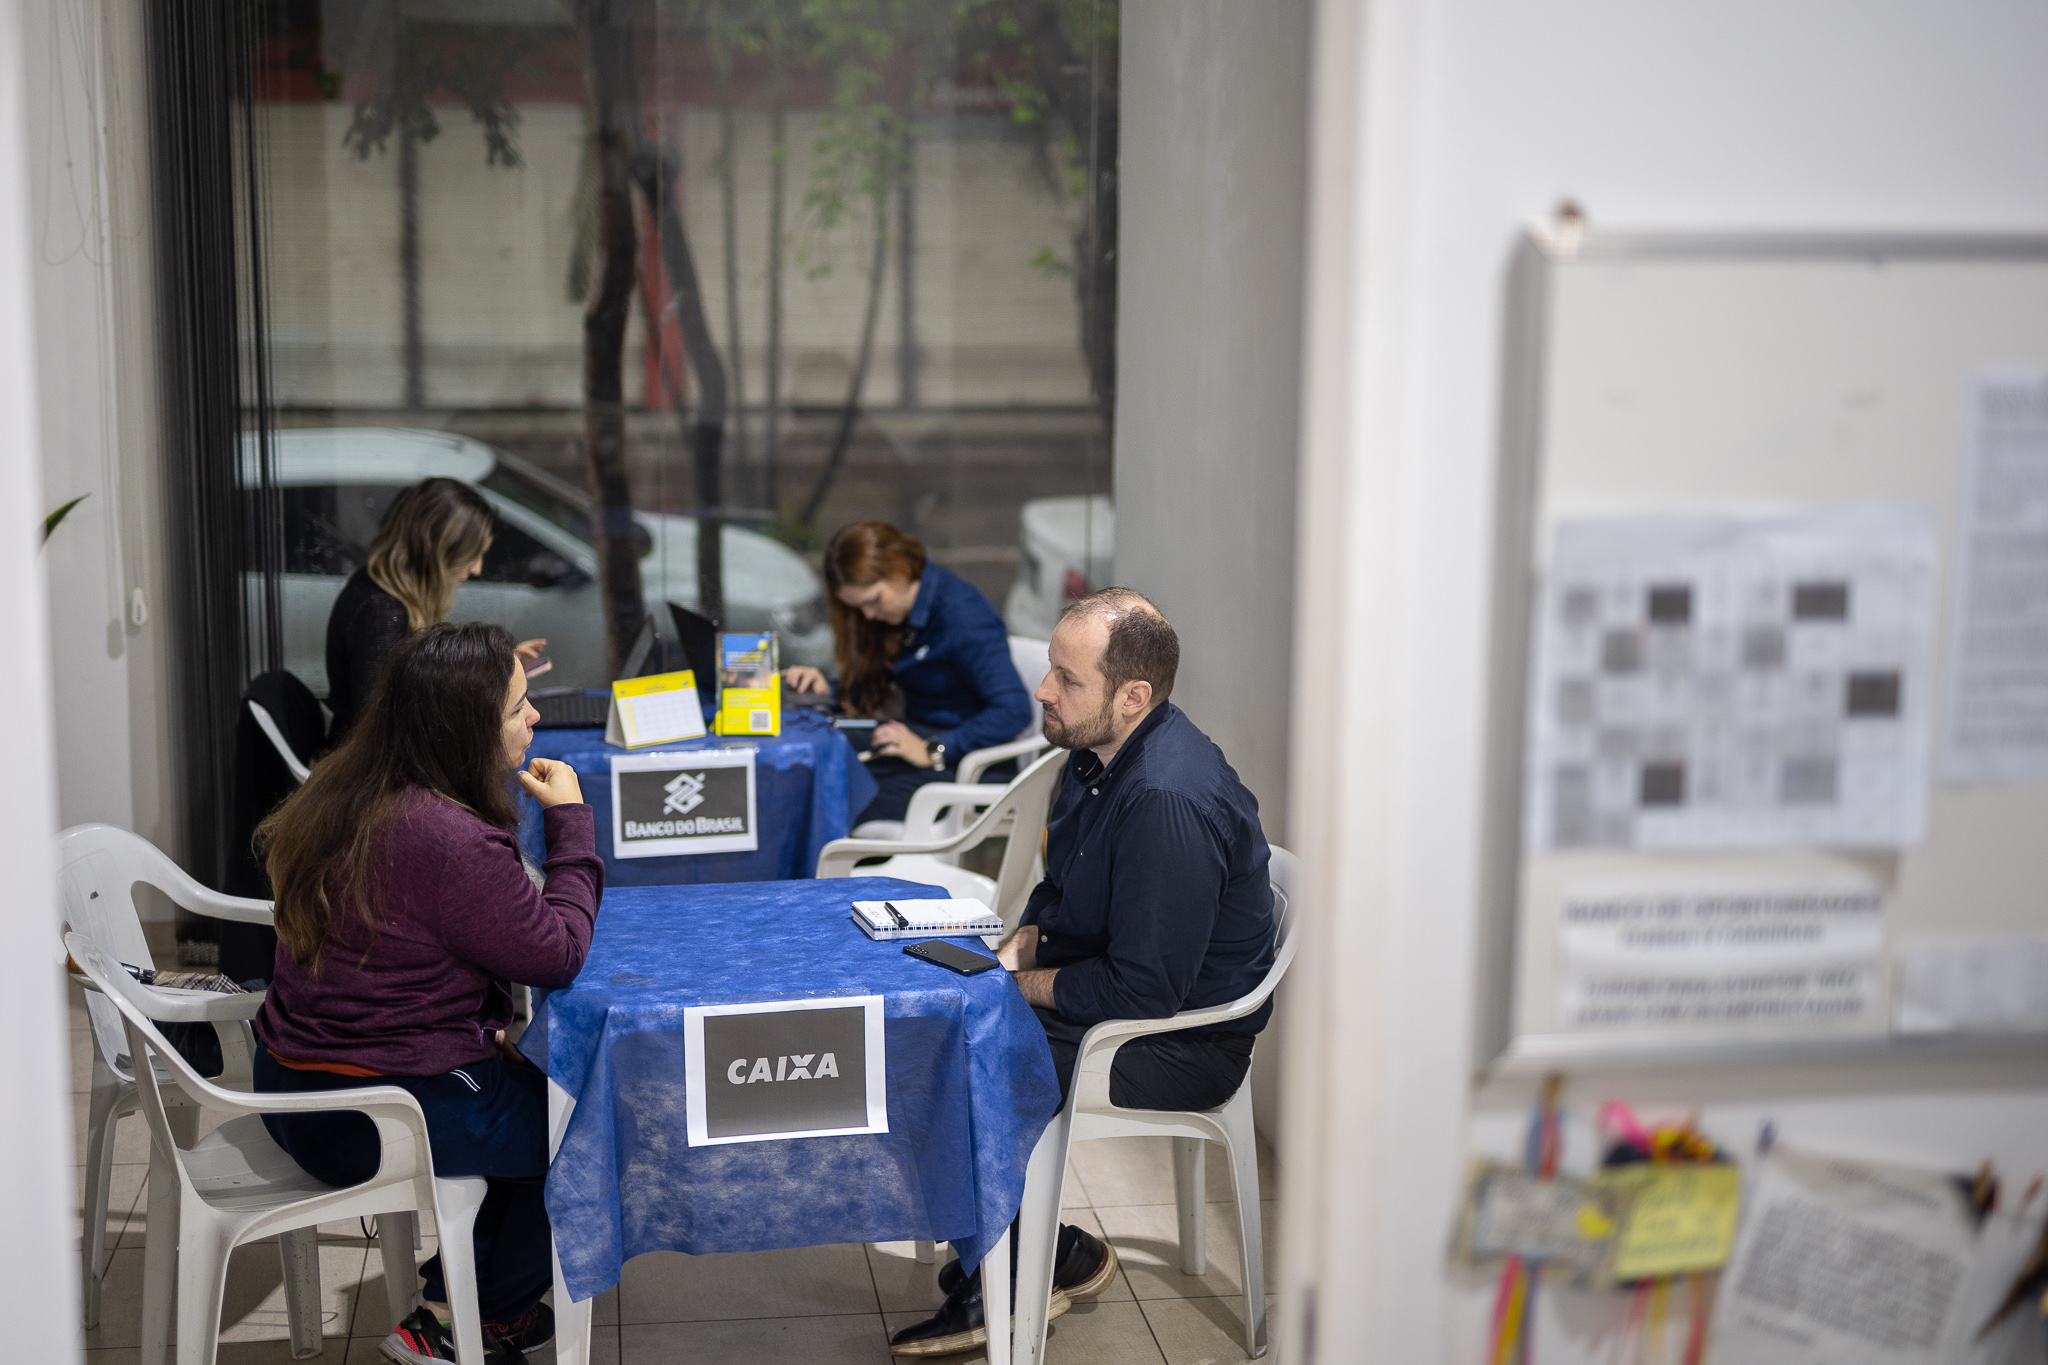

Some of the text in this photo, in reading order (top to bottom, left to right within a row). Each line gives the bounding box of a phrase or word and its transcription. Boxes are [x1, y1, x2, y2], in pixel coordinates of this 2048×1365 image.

[625, 816, 745, 838] BANCO DO BRASIL
[727, 1052, 840, 1085] CAIXA
